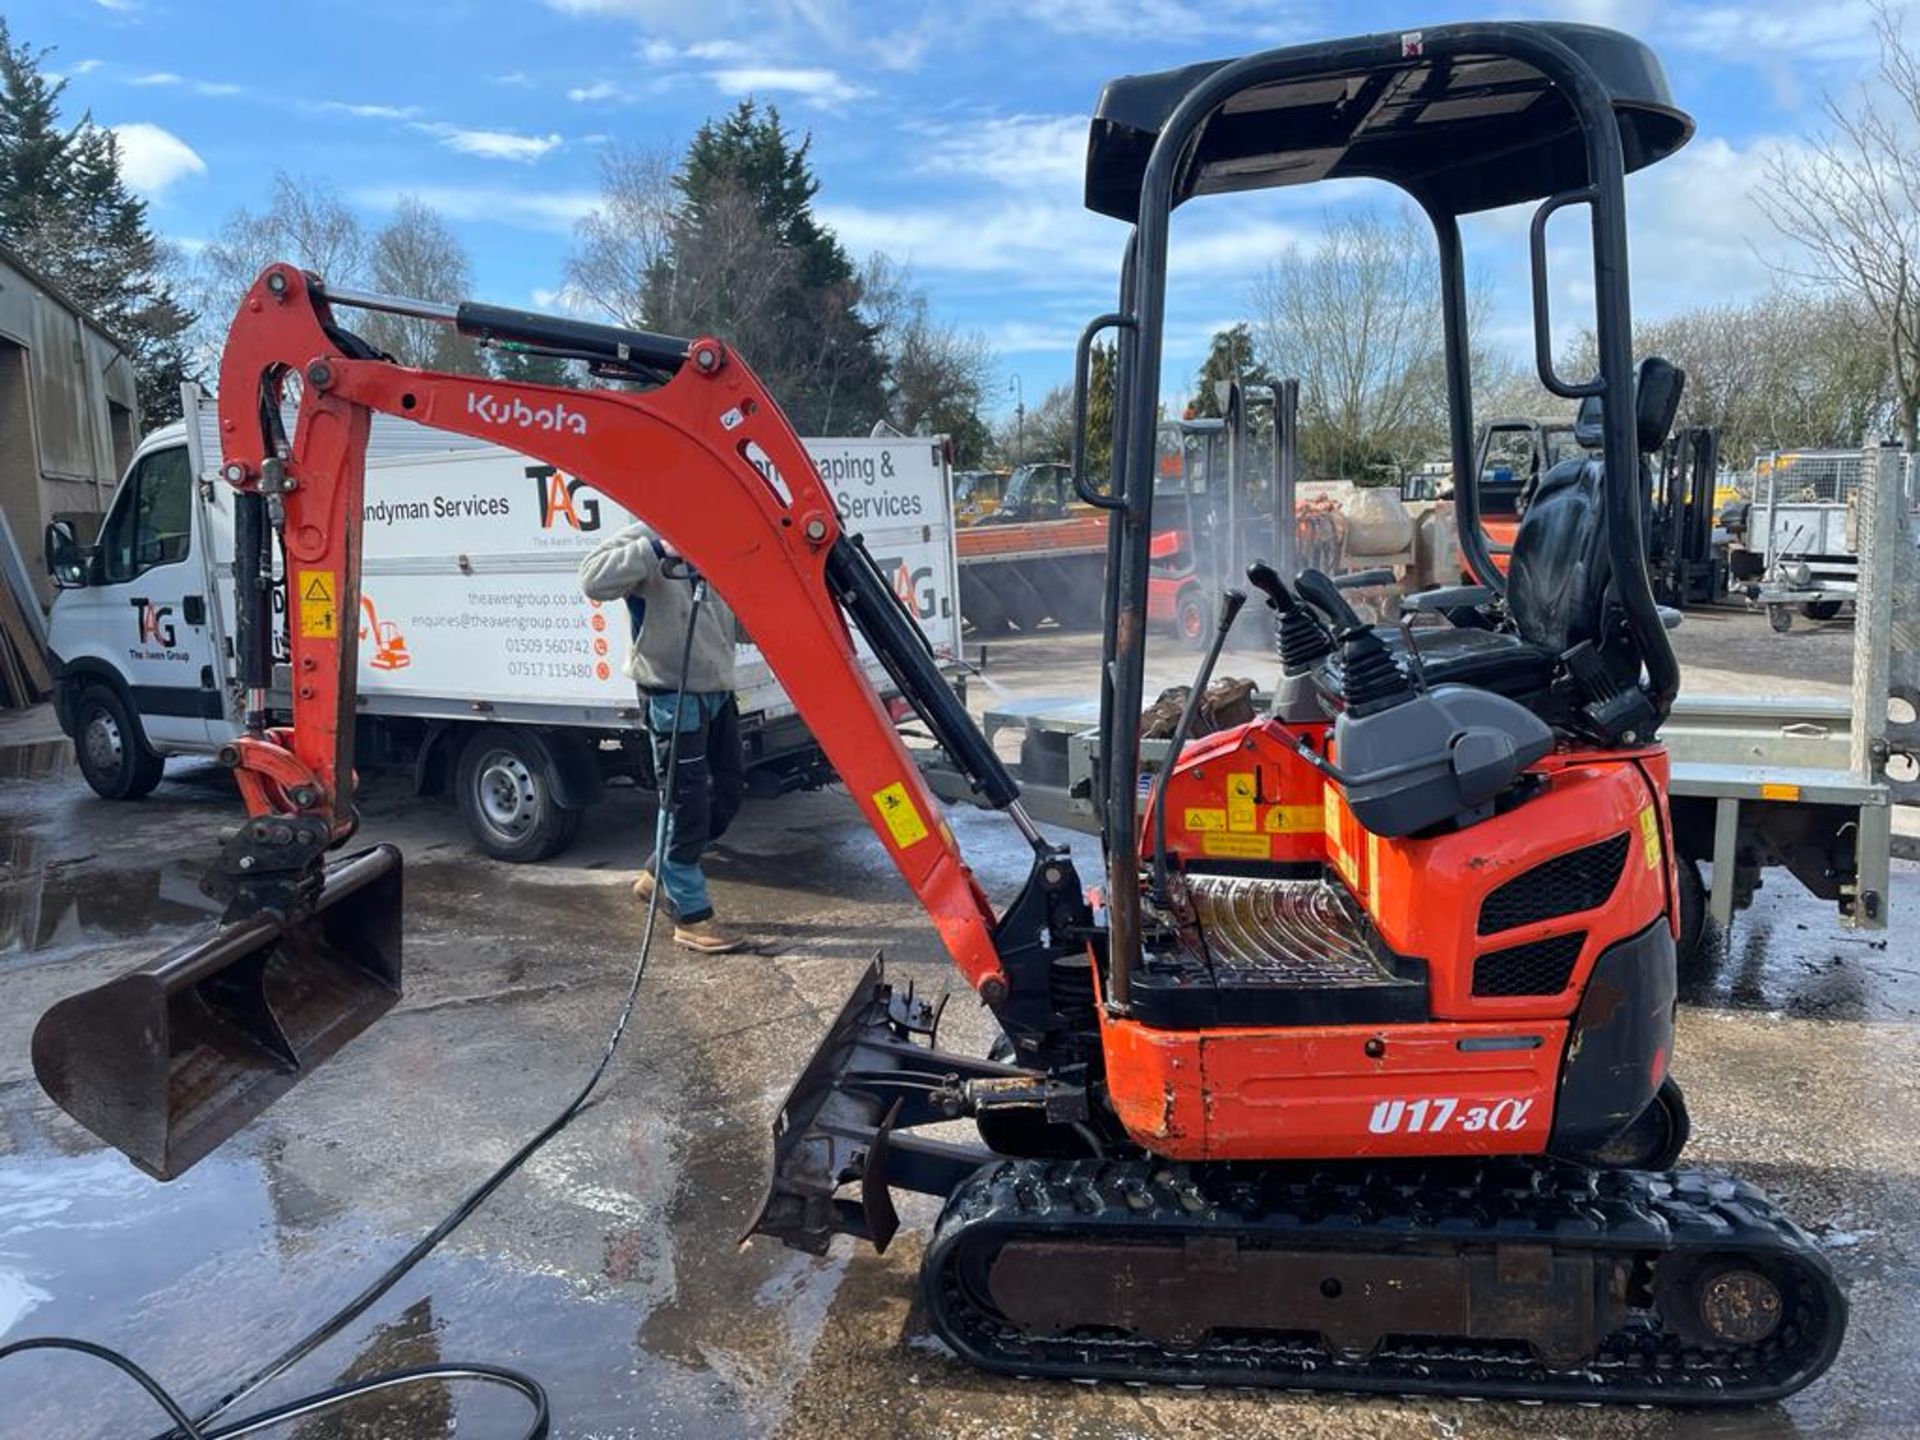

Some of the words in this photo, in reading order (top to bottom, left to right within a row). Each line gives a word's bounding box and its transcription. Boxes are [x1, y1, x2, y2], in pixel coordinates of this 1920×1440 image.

[468, 392, 587, 434] Kubota
[813, 451, 875, 486] aping
[881, 450, 895, 478] &
[363, 500, 430, 526] ndyman
[433, 494, 509, 518] Services
[525, 466, 601, 531] TAG
[837, 490, 922, 519] Services
[467, 591, 586, 609] theawengroup.co.uk
[130, 598, 176, 647] TAG
[505, 638, 543, 654] 01509
[545, 639, 590, 655] 560742
[508, 661, 544, 677] 07517
[547, 664, 592, 679] 115480
